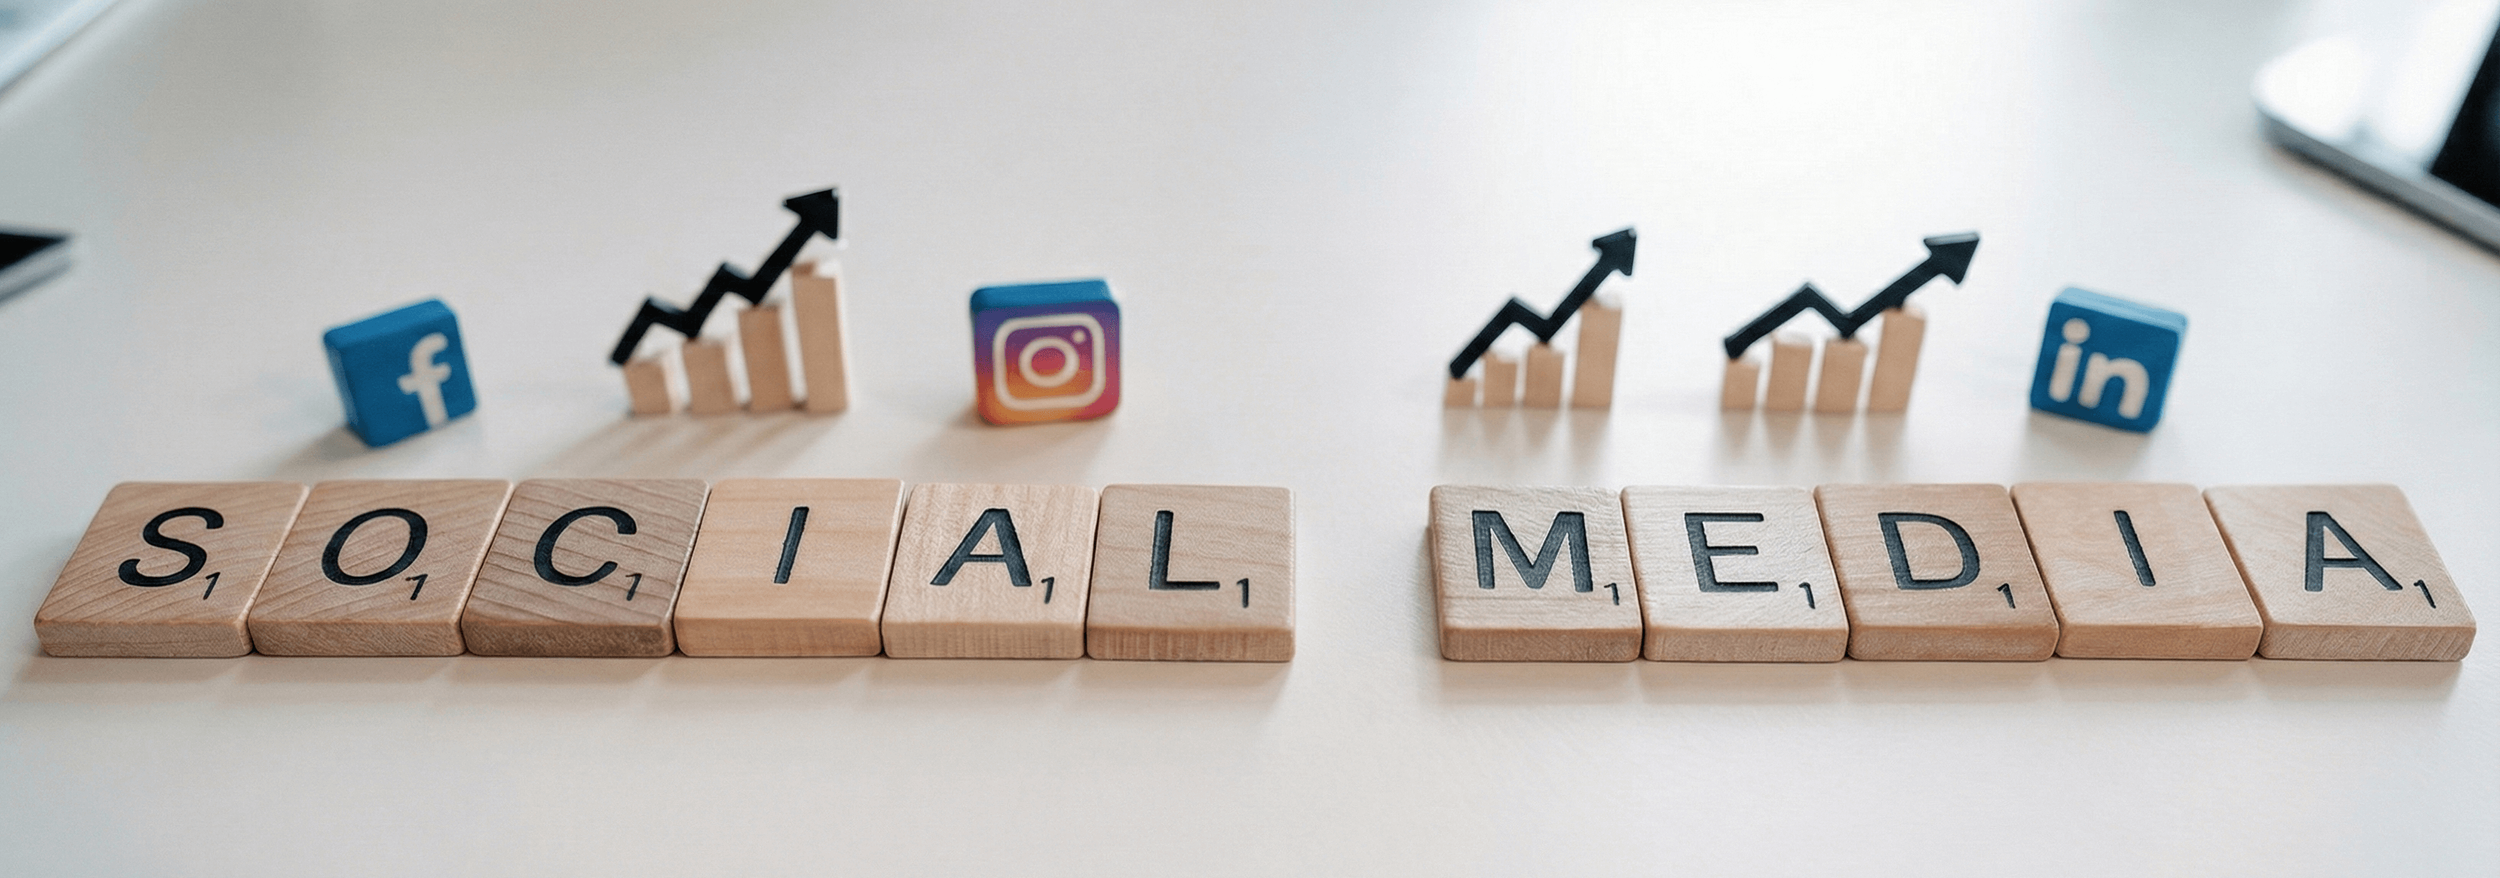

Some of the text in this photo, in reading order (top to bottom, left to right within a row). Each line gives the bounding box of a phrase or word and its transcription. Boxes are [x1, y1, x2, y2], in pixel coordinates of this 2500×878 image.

[2049, 317, 2150, 420] in
[118, 506, 2404, 593] SOCIAL MEDIA
[202, 571, 221, 600] 1
[405, 573, 427, 601] 1
[625, 572, 642, 601] 1
[1040, 576, 1055, 604] 1
[1235, 577, 1250, 608] 1
[1604, 582, 1620, 606] 1
[1799, 582, 1816, 610] 1
[1996, 583, 2016, 609] 1
[2413, 579, 2436, 609] 1
